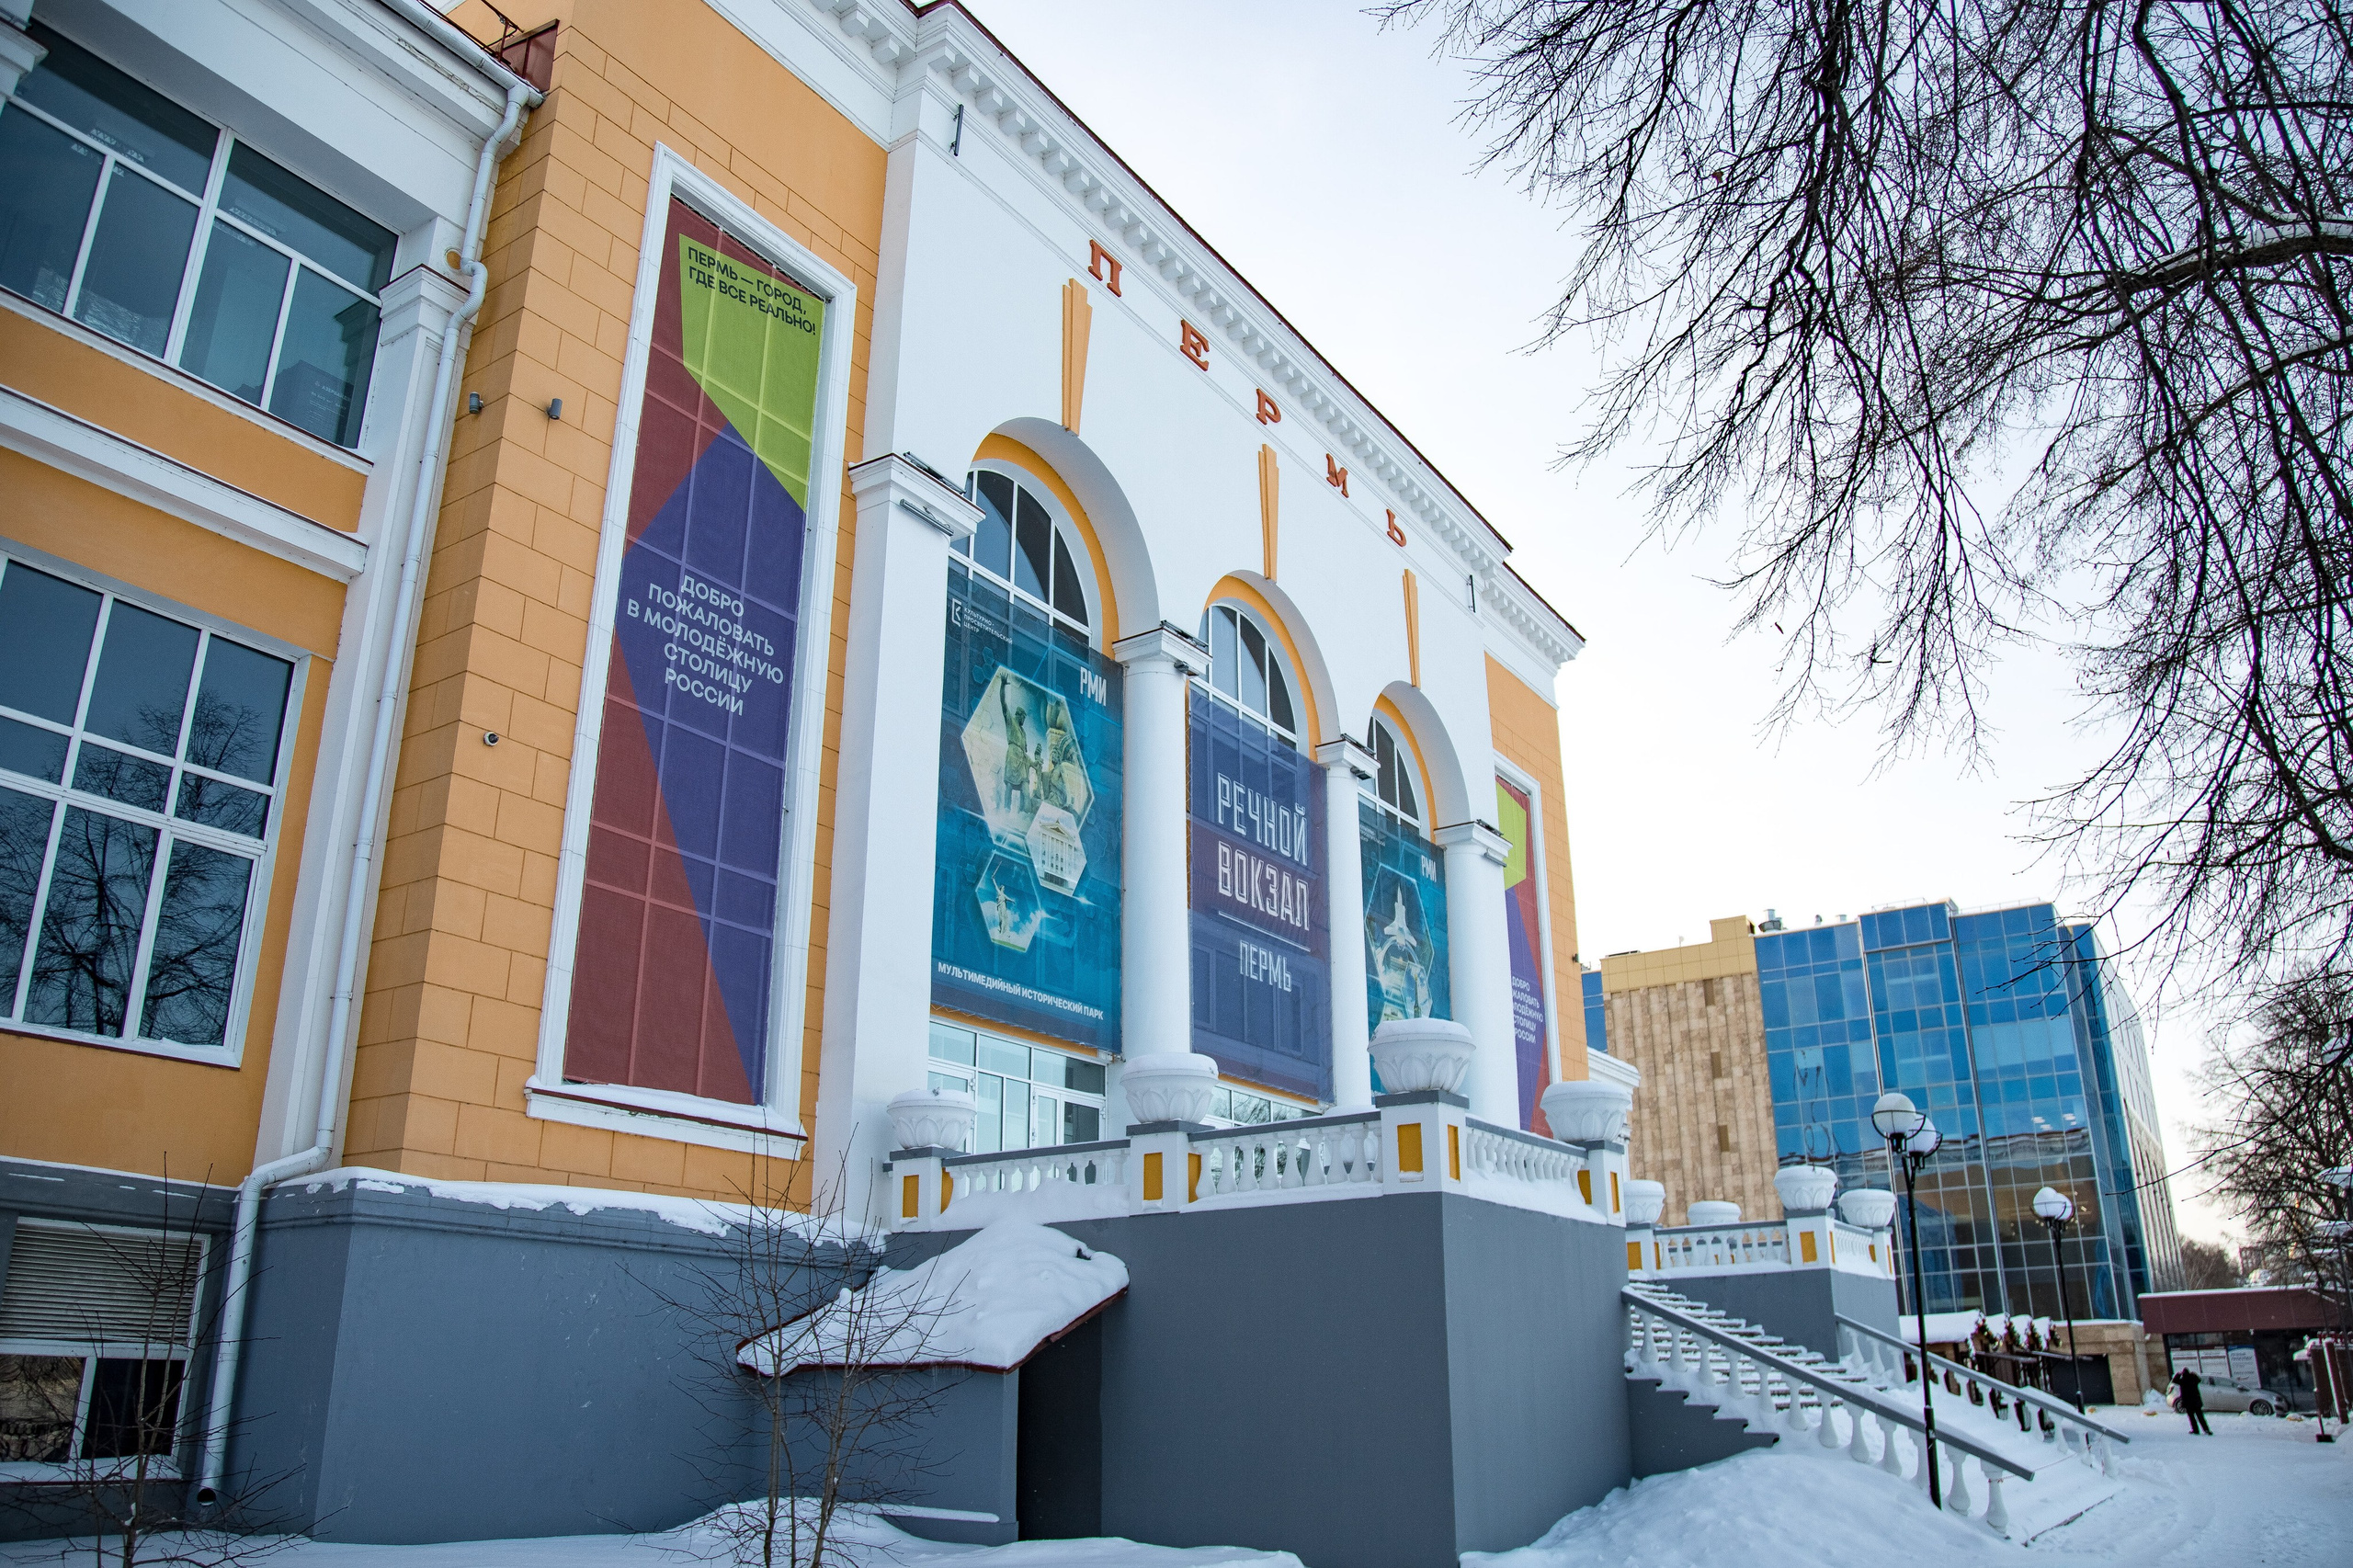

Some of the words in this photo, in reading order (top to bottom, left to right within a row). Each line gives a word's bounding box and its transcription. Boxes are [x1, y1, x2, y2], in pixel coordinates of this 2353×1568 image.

[688, 246, 738, 280] ПЕРМЬ
[756, 278, 807, 315] ГОРОД,
[689, 266, 715, 290] ГДЕ
[719, 280, 746, 303] ВСЕ
[750, 294, 816, 335] РЕАЛЬНО!
[1088, 239, 1406, 547] ПЕРМЬ
[648, 583, 775, 656] ПОЖАЛОВАТЬ
[681, 575, 744, 617] ДОБРО
[627, 598, 640, 618] В
[643, 608, 784, 684] МОЛОДЁЖНУЮ
[964, 621, 980, 633] ЦЕНТР
[664, 642, 752, 693] СТОЛИЦУ
[665, 667, 744, 716] РОССИИ
[1080, 666, 1107, 707] РМИ
[1218, 772, 1308, 867] РЕЧНОЙ
[1218, 840, 1310, 932] ВОКЗАЛ
[938, 961, 1021, 996] МУЛЬТИМЕДИЙНЫЙ
[1021, 989, 1083, 1015] ИСТОРИЧЕСКИЙ
[1084, 1006, 1104, 1020] ПАРК
[1240, 939, 1292, 993] ПЕРМЬ
[1512, 976, 1530, 992] ДОБРО
